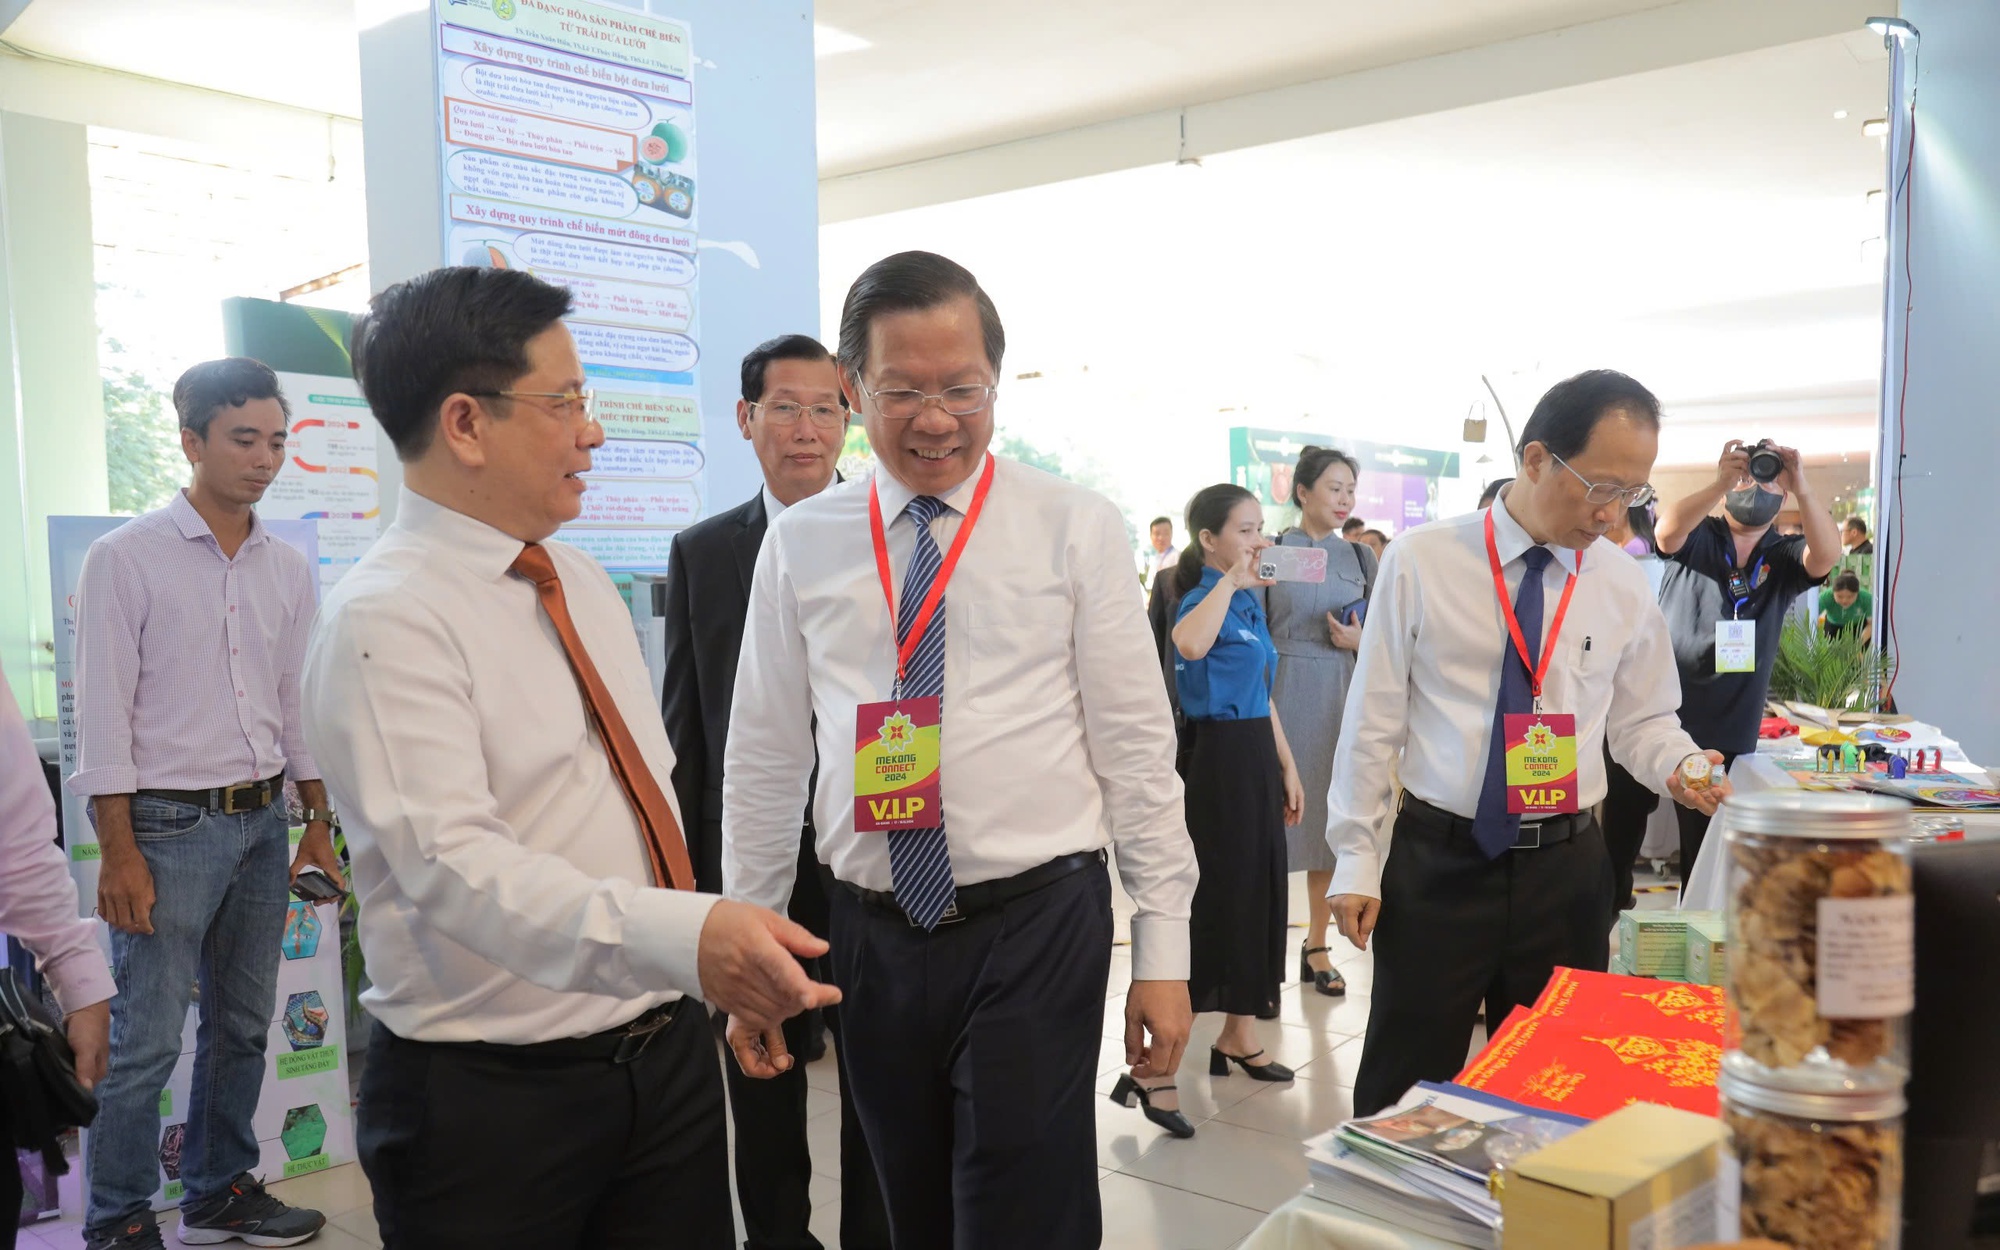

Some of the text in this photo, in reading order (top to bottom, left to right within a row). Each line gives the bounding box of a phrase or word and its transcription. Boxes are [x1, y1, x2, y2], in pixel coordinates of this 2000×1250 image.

[521, 0, 681, 44] ĐA DẠNG HÓA SẢN PHẨM CHẾ BIẾN
[560, 21, 646, 50] TỪ TRÁI DƯA LƯỚI
[474, 40, 670, 93] Xây dựng quy trình chế biến bột dưa lưới
[466, 205, 487, 218] Xây
[489, 208, 516, 223] dựng
[518, 215, 538, 226] quy
[540, 215, 564, 228] trình
[566, 219, 583, 230] chế
[585, 222, 605, 234] biến
[607, 227, 626, 237] mứt
[653, 232, 670, 243] dưa
[672, 235, 690, 246] lưới
[876, 754, 916, 765] MEKONG
[876, 763, 916, 774] CONNECT
[885, 773, 906, 781] 2024
[868, 797, 925, 820] V.I.P
[1519, 789, 1566, 805] V.I.P
